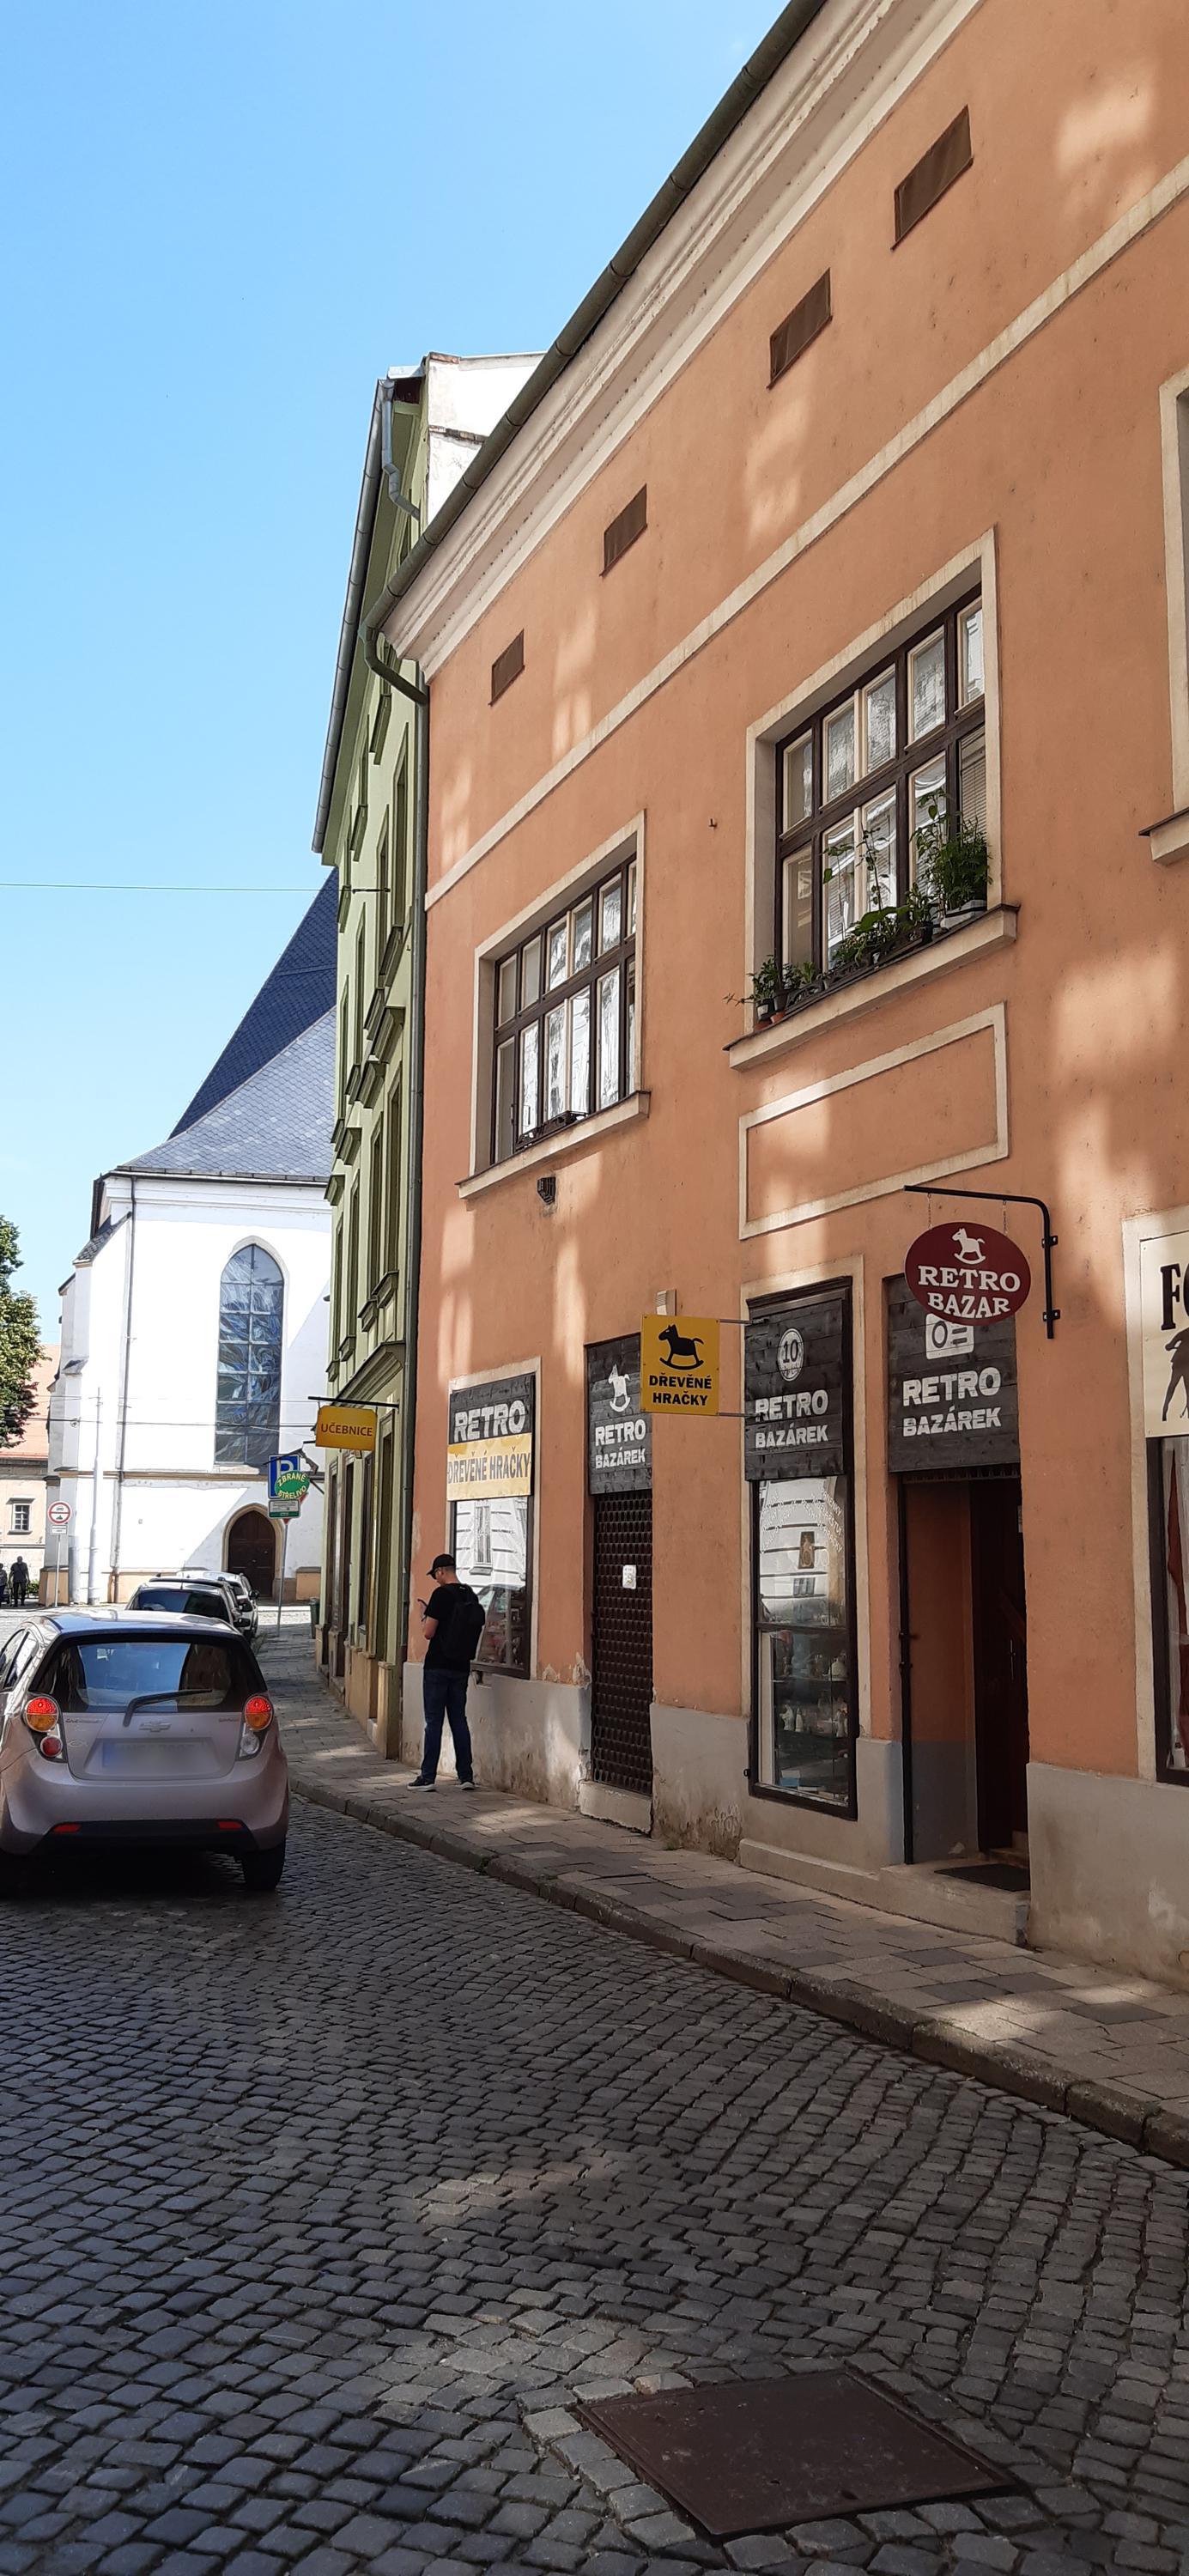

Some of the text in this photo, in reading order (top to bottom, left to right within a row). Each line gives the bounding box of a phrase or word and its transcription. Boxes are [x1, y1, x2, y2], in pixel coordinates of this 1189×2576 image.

[918, 1265, 1021, 1292] RETRO
[927, 1292, 1011, 1319] BAZAR
[1160, 1262, 1189, 1331] F
[783, 1340, 798, 1363] 10
[649, 1372, 713, 1389] DŘEVĚNÉ
[902, 1367, 1001, 1406] RETRO
[652, 1390, 708, 1406] HRAČKY
[755, 1389, 828, 1422] RETRO
[320, 1422, 373, 1437] UČEBNICE
[453, 1400, 526, 1443] RETRO
[595, 1419, 646, 1447] RETRO
[902, 1405, 1002, 1437] BAZÁREK
[755, 1422, 828, 1449] BAZÁREK
[447, 1446, 531, 1484] DŘEVĚNÉ HRAČKY
[595, 1446, 646, 1469] BAZÁREK
